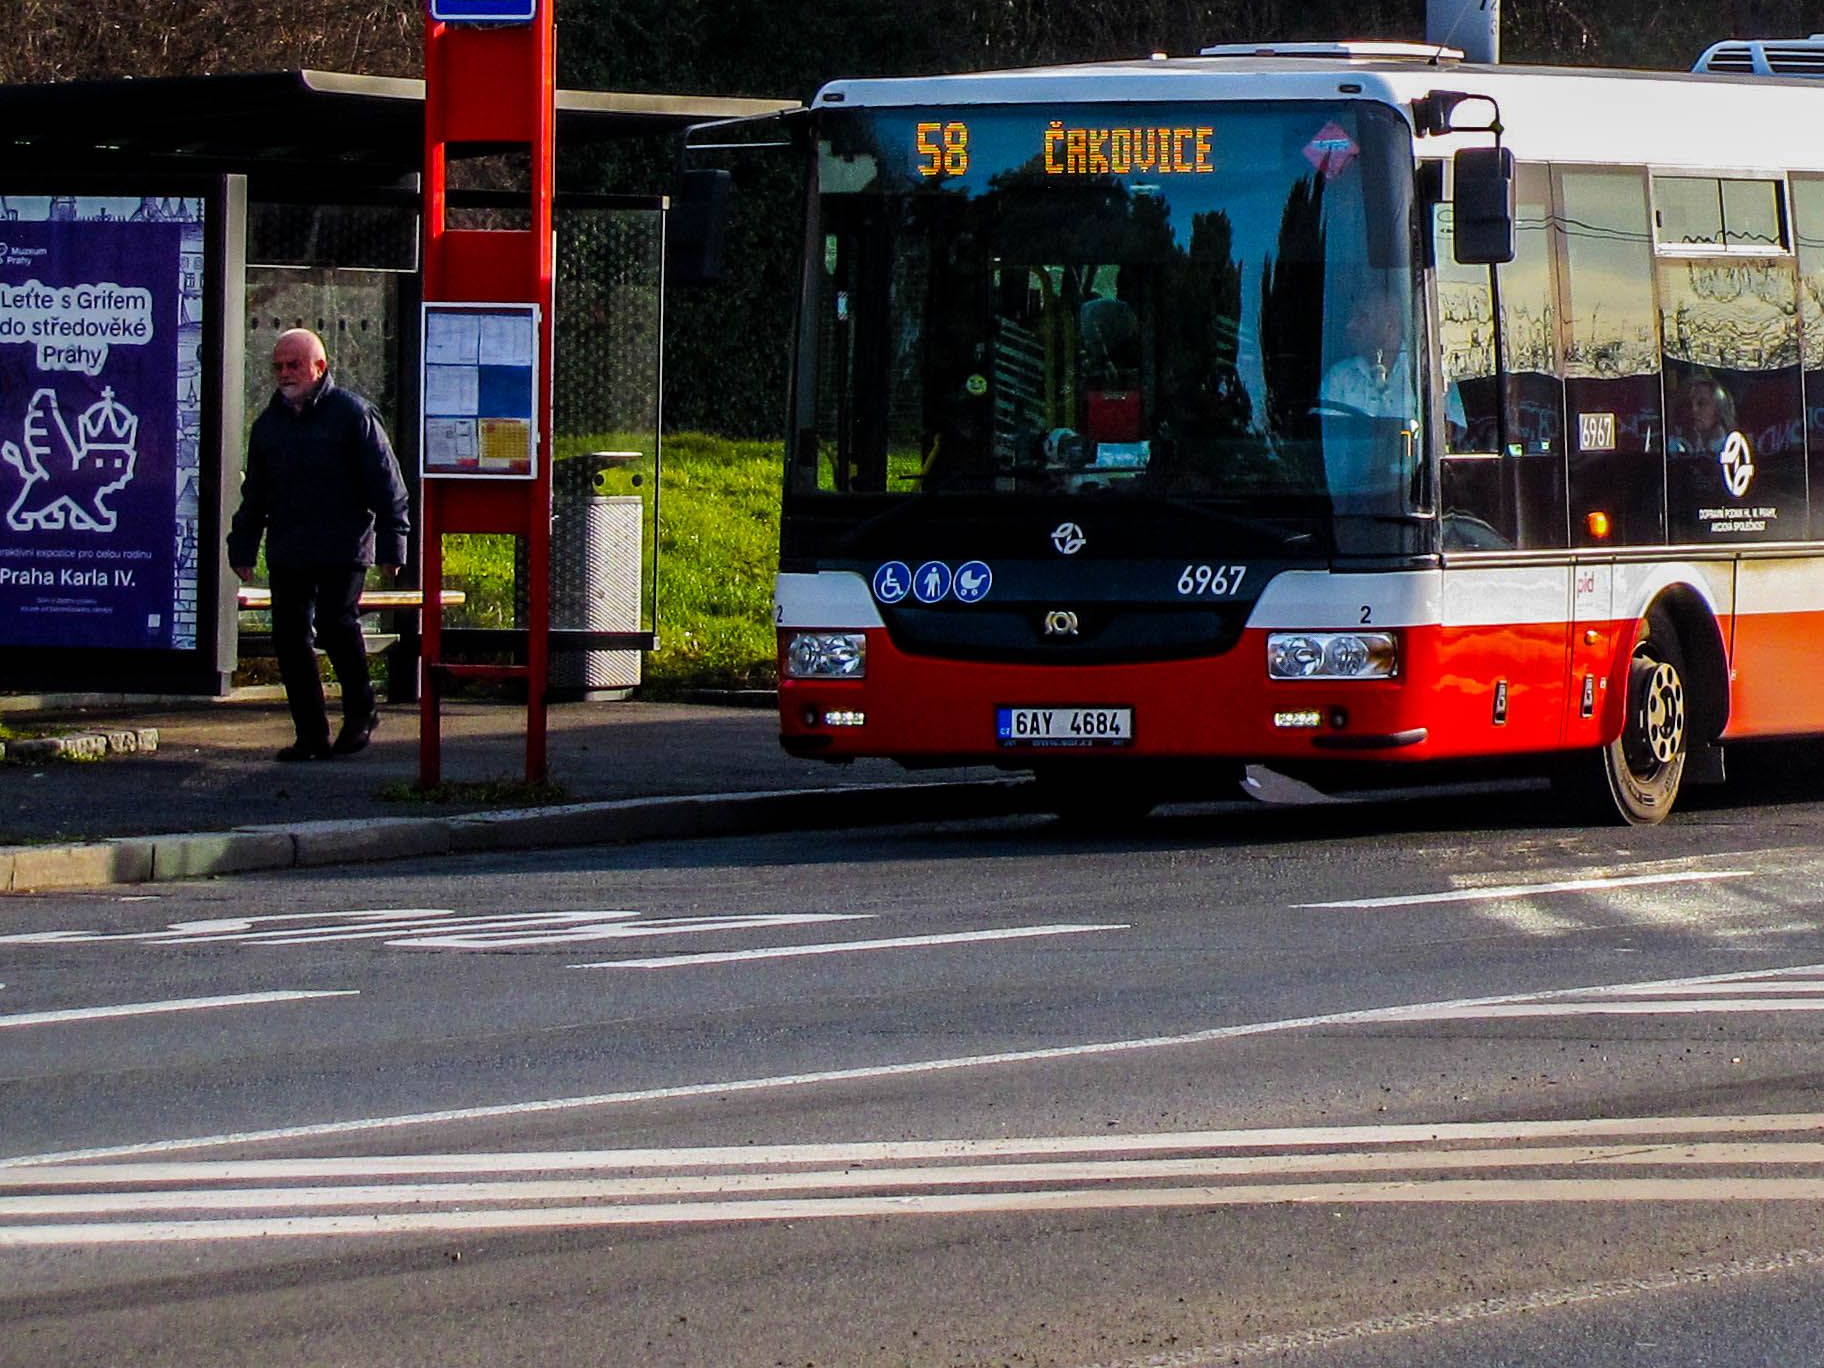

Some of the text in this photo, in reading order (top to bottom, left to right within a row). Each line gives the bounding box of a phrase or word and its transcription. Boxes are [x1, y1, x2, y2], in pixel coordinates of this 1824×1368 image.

[916, 122, 969, 176] 58
[1044, 120, 1214, 174] ČAKOVICE
[1, 287, 146, 309] Leťte s Grifem
[0, 316, 147, 337] do středověké
[43, 345, 102, 368] Prahy
[1582, 417, 1612, 447] 6967
[0, 568, 136, 586] Praha Karla IV.
[1178, 565, 1247, 595] 6967
[777, 604, 783, 623] 2
[1360, 605, 1372, 624] 2
[1016, 712, 1121, 735] 6AY 4684
